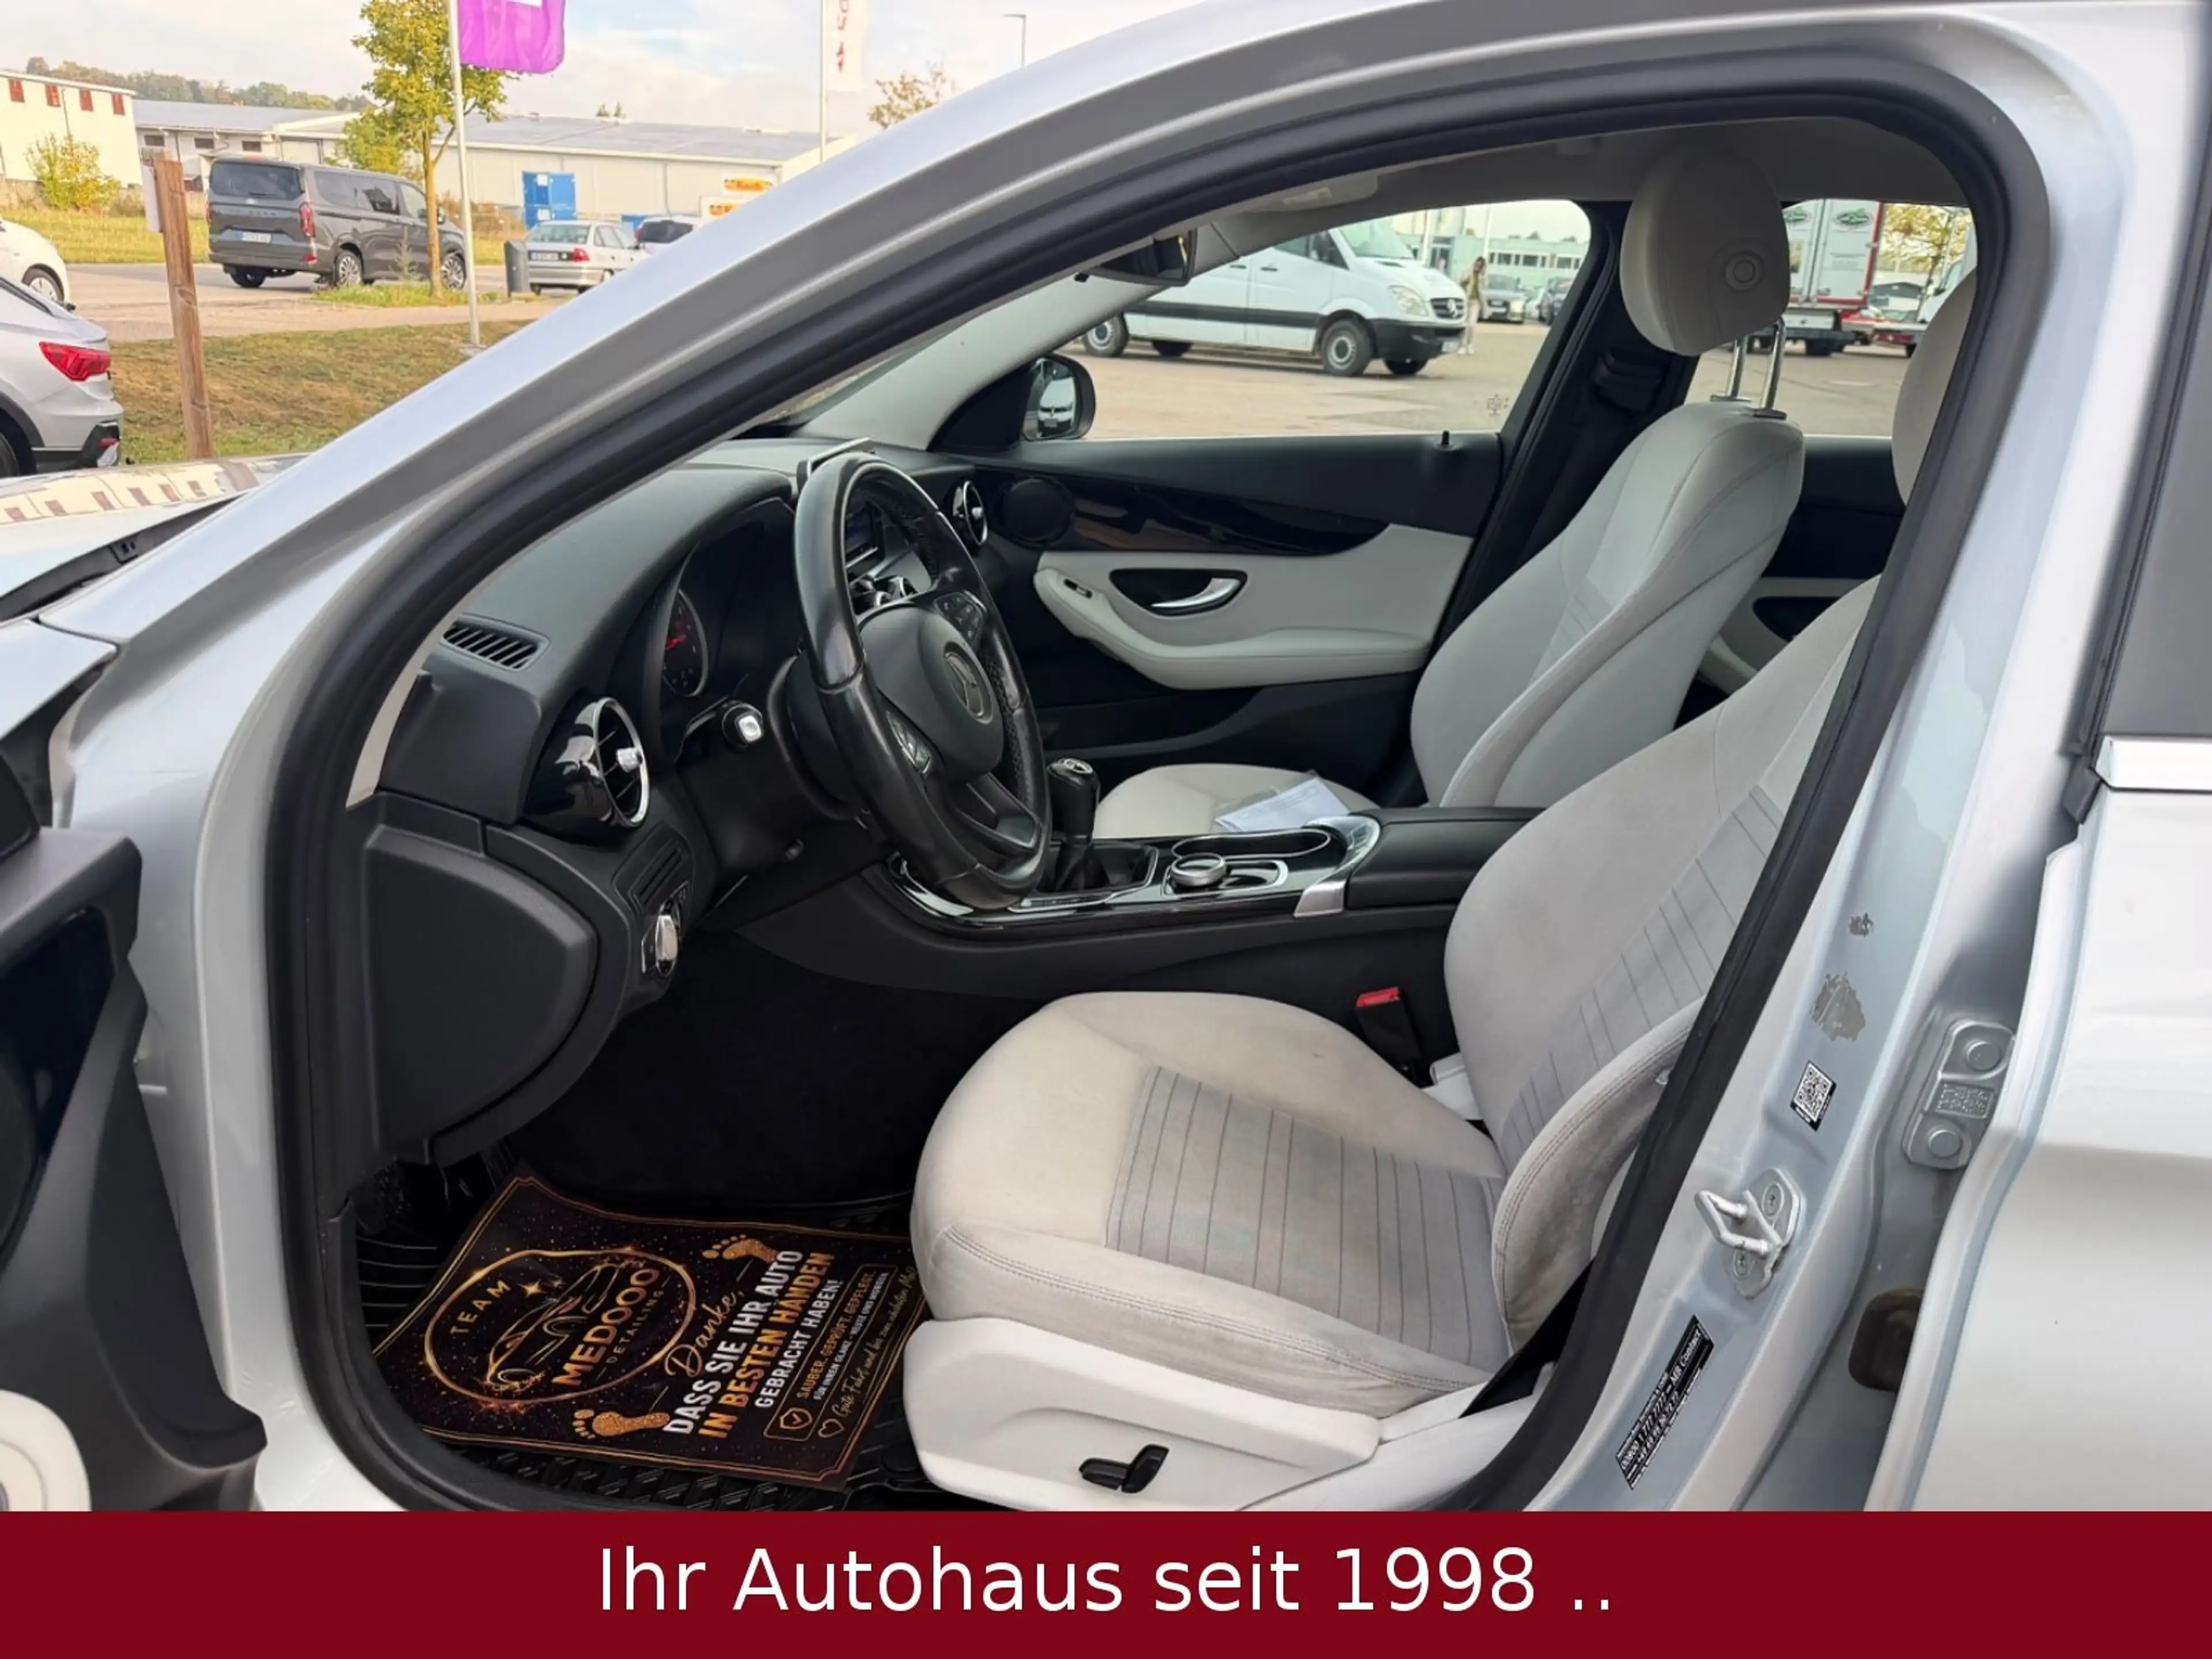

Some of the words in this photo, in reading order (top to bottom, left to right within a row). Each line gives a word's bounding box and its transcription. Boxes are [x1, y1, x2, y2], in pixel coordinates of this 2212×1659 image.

[450, 1279, 512, 1334] TEAM
[552, 1268, 660, 1386] MEDOOO
[607, 1290, 664, 1365] DETAILING
[663, 1380, 721, 1434] DASS
[705, 1340, 747, 1374] SIE
[728, 1301, 772, 1334] IHR
[755, 1251, 804, 1297] AUTO
[665, 1291, 745, 1378] Danke,
[698, 1412, 738, 1438] IN
[718, 1329, 787, 1407] BESTEN
[769, 1252, 835, 1323] HÄNDEN
[755, 1330, 813, 1408] GEBRACHT
[801, 1279, 844, 1328] HABEN!
[797, 1358, 828, 1399] SAUBER.
